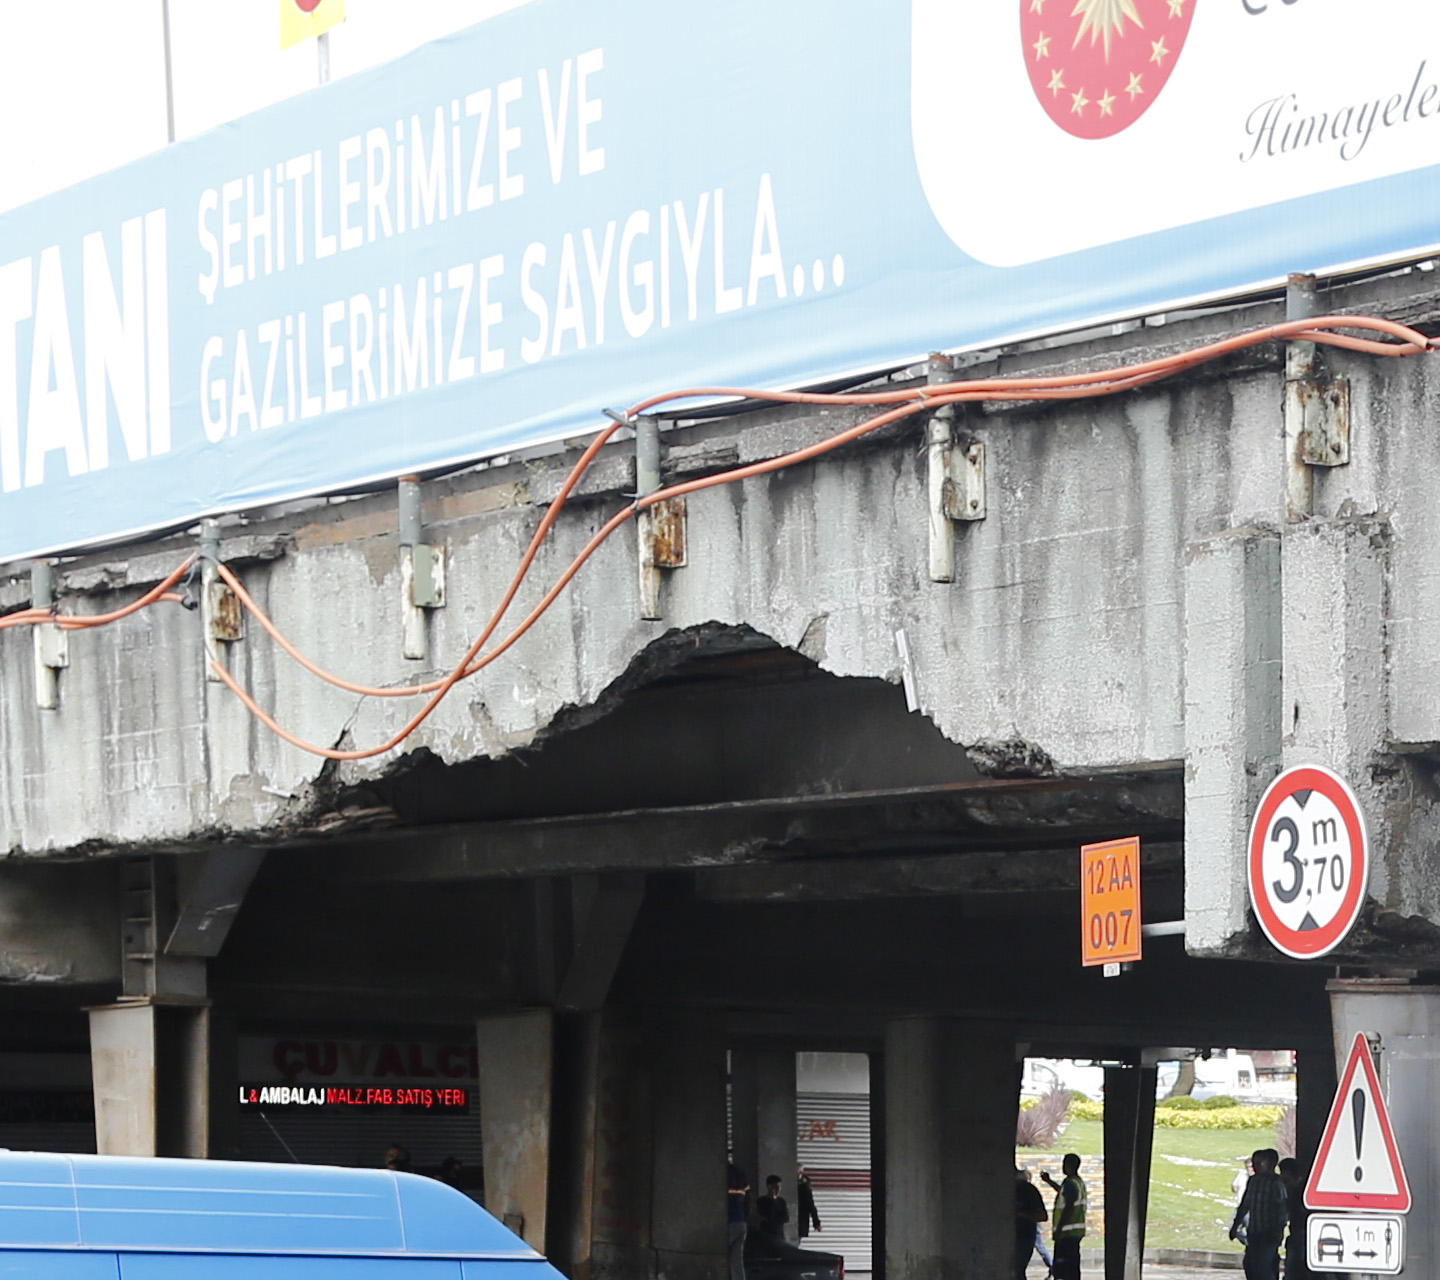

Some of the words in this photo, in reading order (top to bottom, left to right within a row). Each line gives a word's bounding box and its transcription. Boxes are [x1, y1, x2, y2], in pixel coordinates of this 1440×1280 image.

[197, 76, 525, 304] ŞEHİTLERİMİZE
[537, 47, 606, 185] VE
[199, 253, 505, 444] GAZİLERİMİZE
[520, 172, 846, 364] SAYGIYLA...
[1090, 909, 1134, 950] 007
[259, 1086, 326, 1105] AMBALAJ
